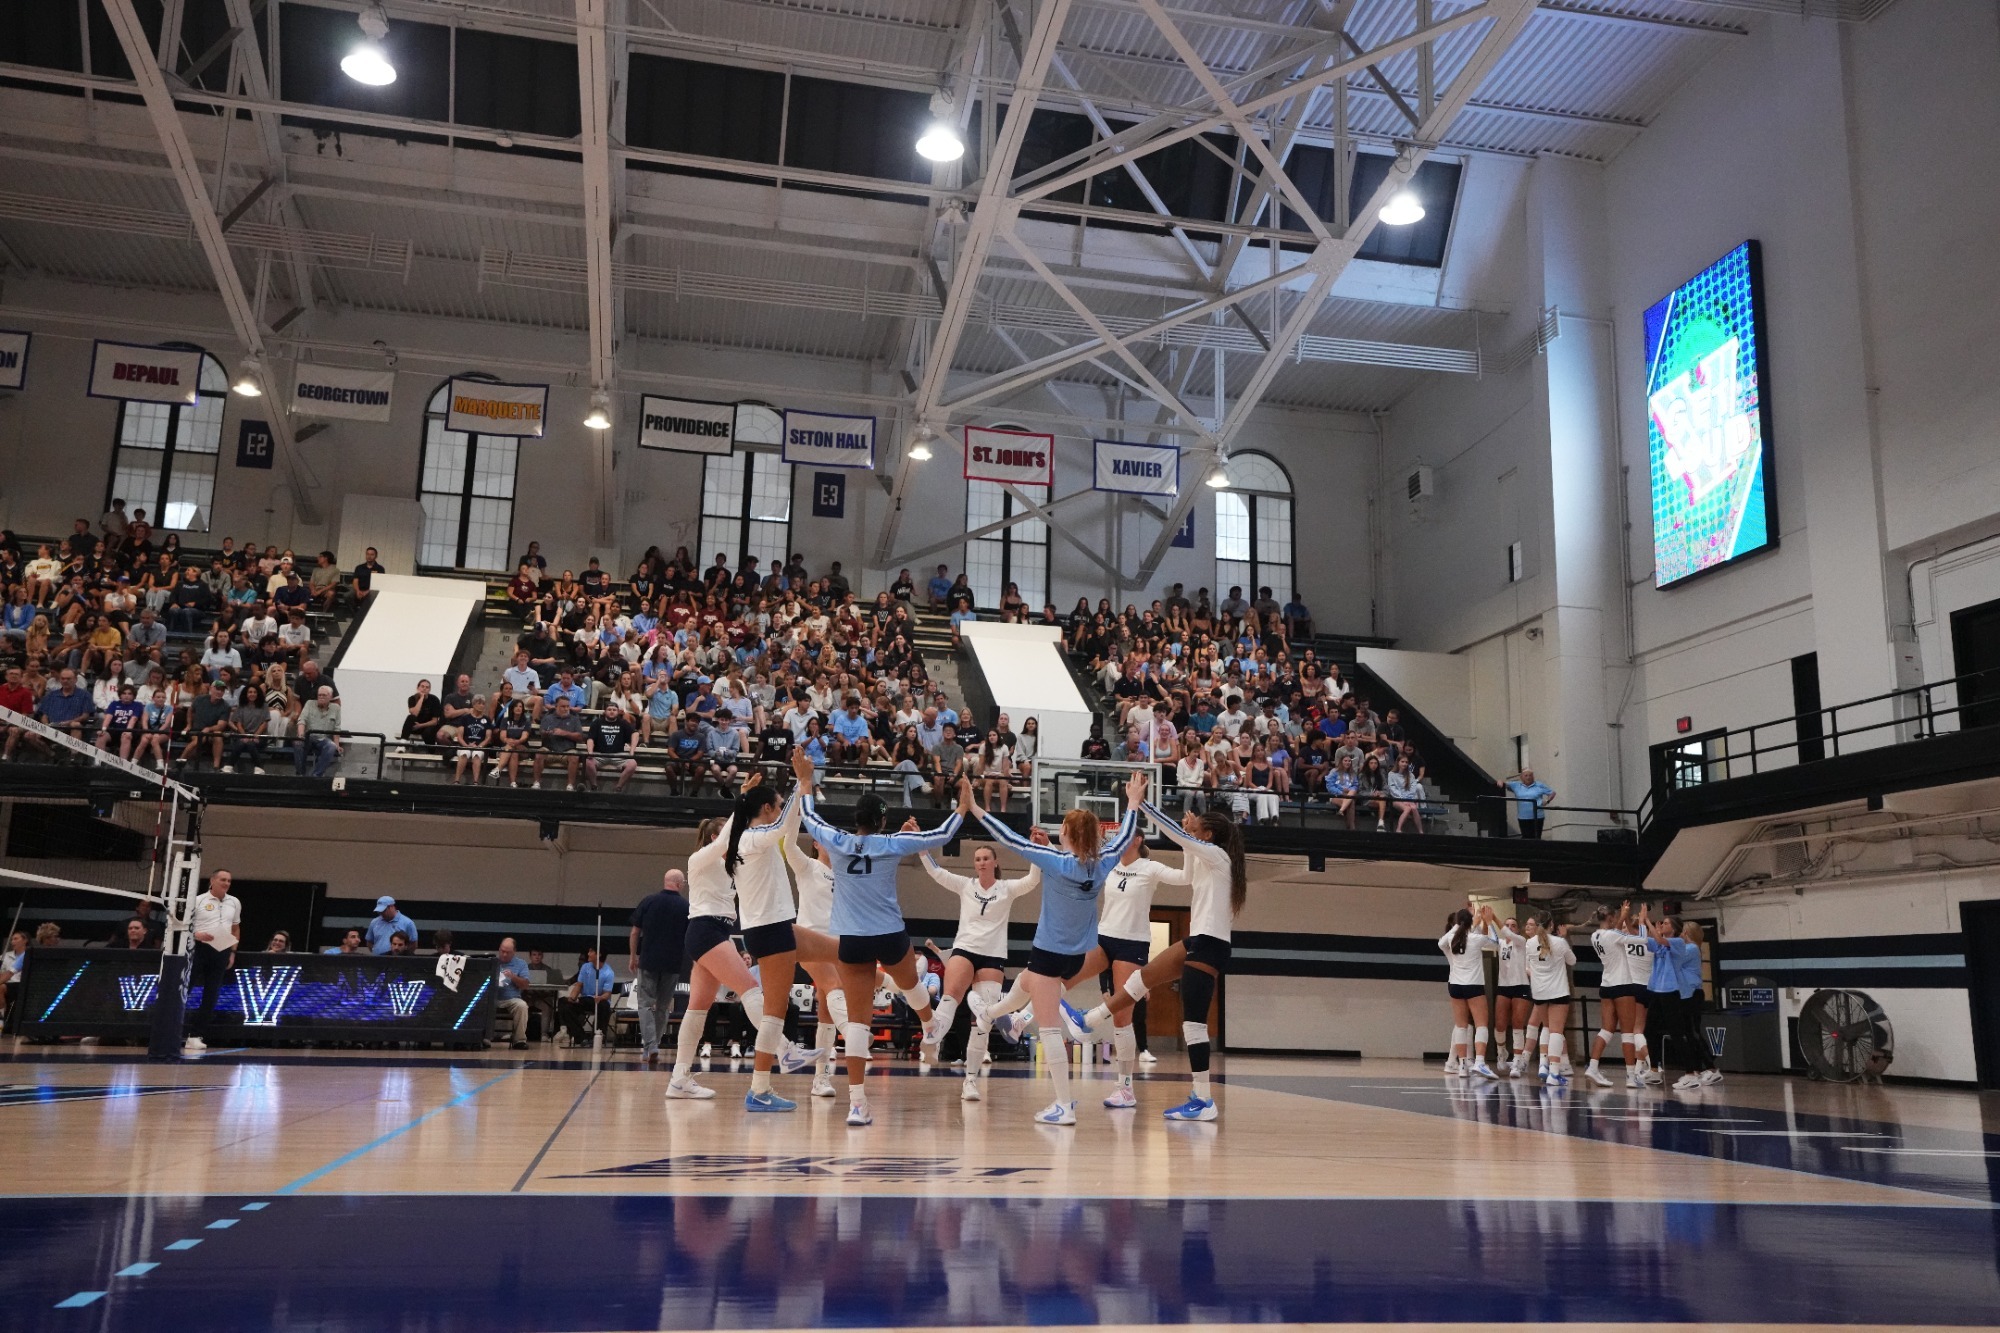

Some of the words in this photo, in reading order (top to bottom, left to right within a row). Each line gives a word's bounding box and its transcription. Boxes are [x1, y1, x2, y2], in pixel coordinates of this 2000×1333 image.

[113, 362, 179, 386] DEPAUL
[297, 383, 389, 406] GEORGETOWN
[452, 396, 542, 421] MARQUETTE
[645, 414, 730, 439] PROVIDENCE
[246, 433, 268, 456] E2
[790, 429, 835, 448] SETON
[836, 431, 868, 450] HALL
[972, 445, 994, 465] ST.
[996, 447, 1046, 468] JOHN'S
[1112, 459, 1162, 478] XAVIER
[820, 484, 838, 506] E3
[846, 854, 872, 874] 21
[1117, 878, 1127, 891] 4
[980, 901, 988, 916] 7
[1502, 951, 1511, 961] 24
[1627, 944, 1645, 956] 20
[234, 966, 302, 1026] V
[1705, 1027, 1726, 1057] V
